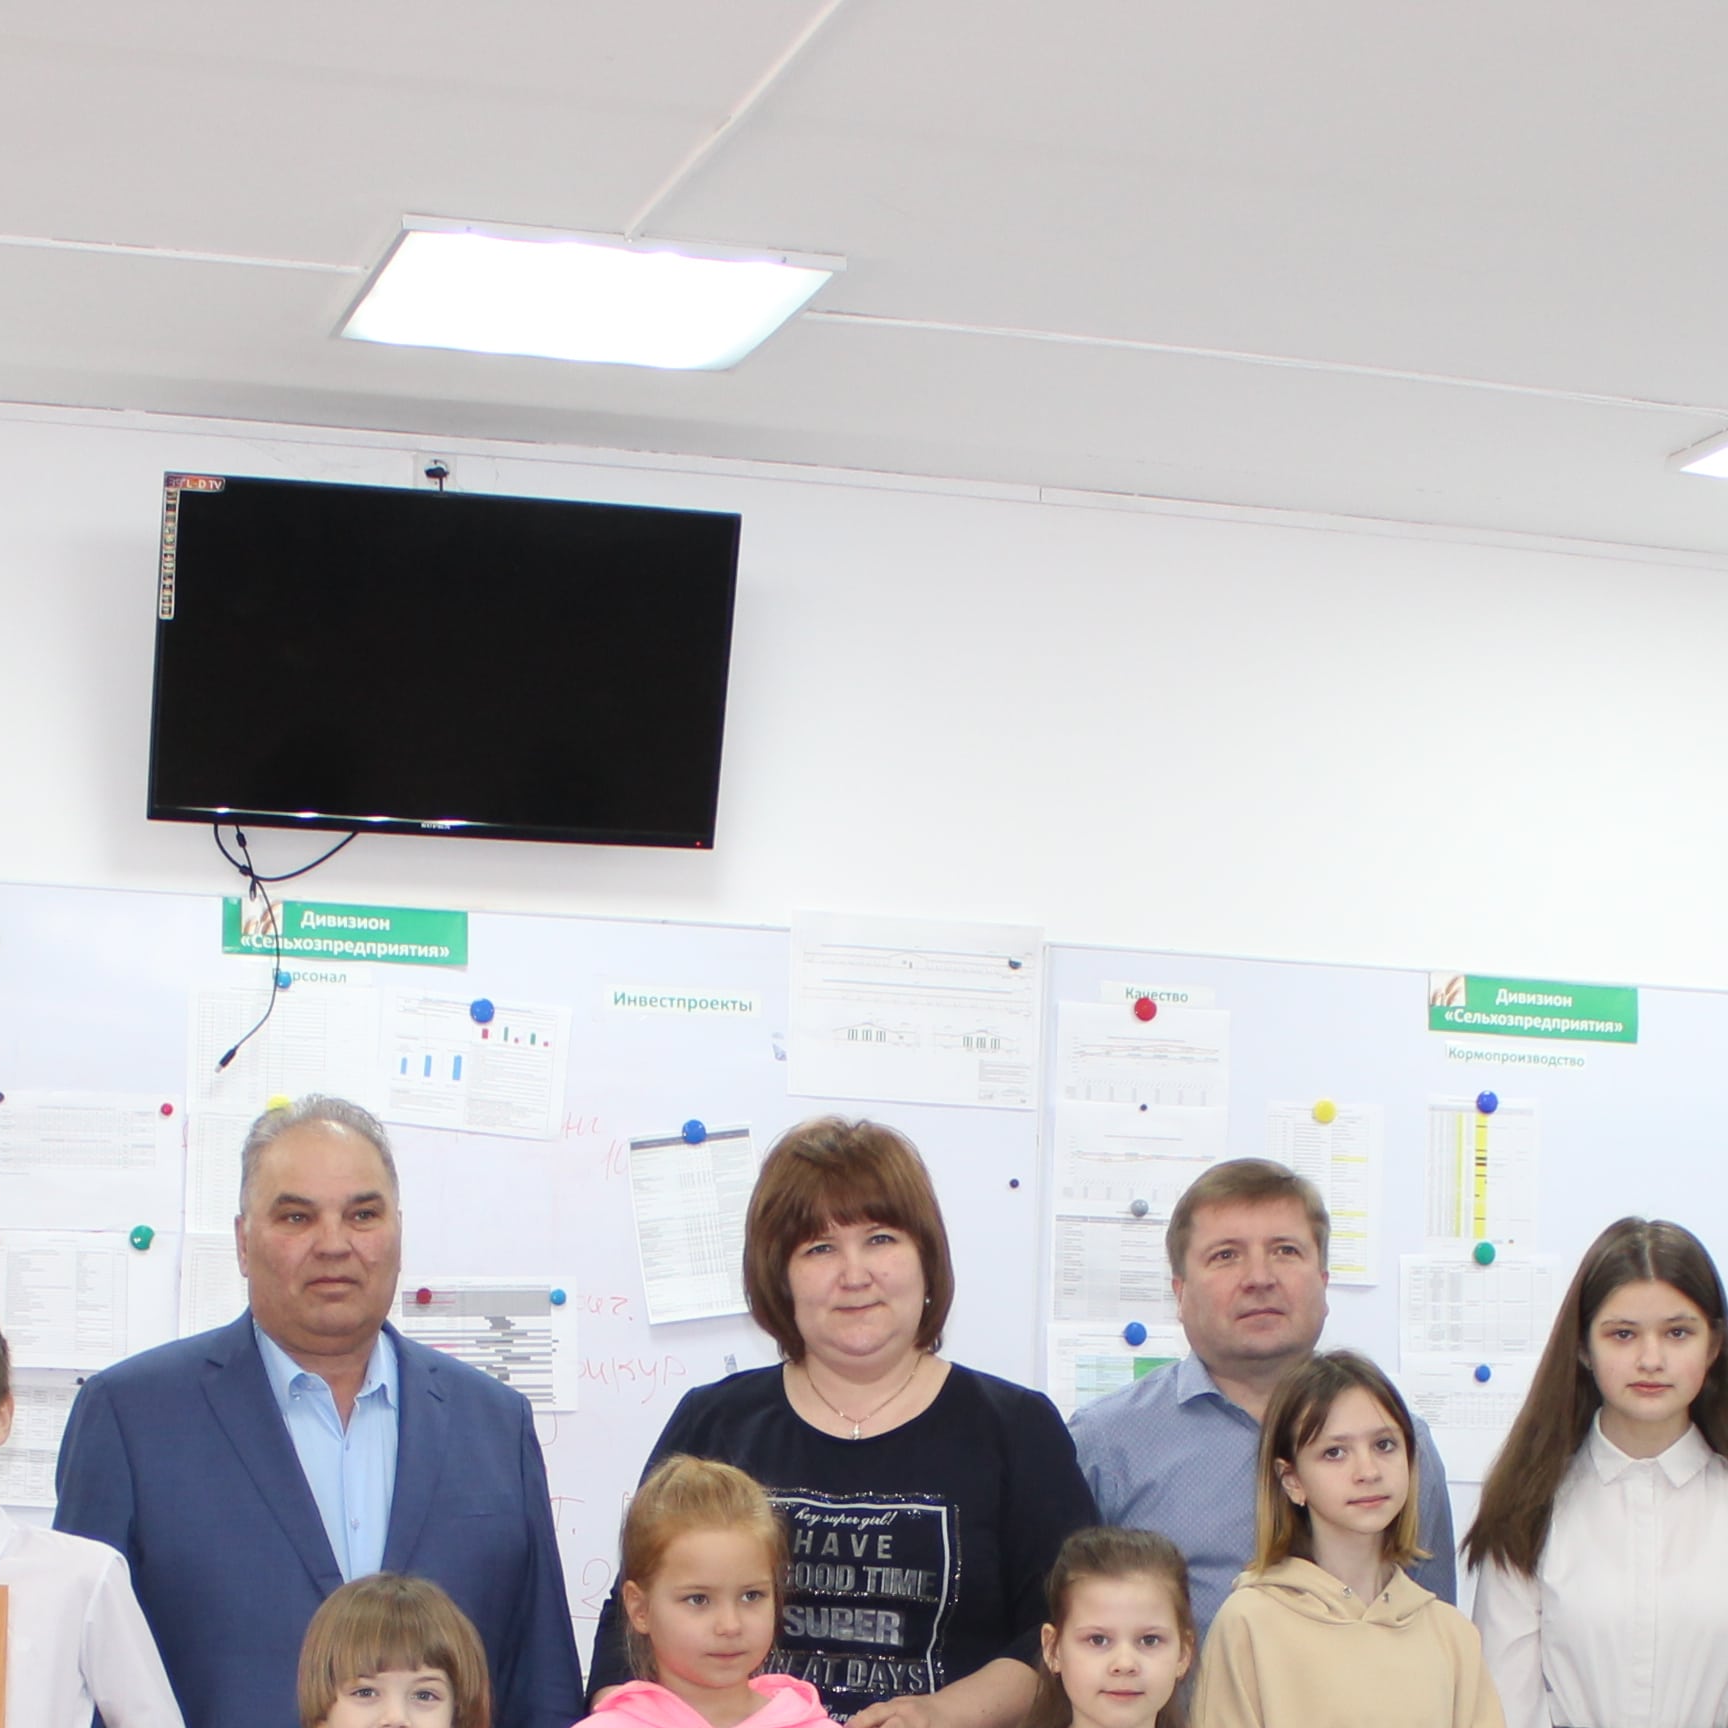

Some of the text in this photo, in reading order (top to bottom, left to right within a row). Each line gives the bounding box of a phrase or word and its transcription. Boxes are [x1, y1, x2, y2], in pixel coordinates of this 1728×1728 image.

[300, 910, 391, 933] Дивизион
[239, 933, 450, 960] «Сельхозпредприятия»
[612, 991, 754, 1013] Инвестпроекты
[1124, 986, 1189, 1003] Качество
[1494, 987, 1573, 1008] Дивизион
[1443, 1008, 1623, 1034] «Сельхозпредприятия»
[1446, 1045, 1586, 1068] Кормопроизводство
[793, 1529, 893, 1560] HAVE
[862, 1565, 938, 1597] TIME
[782, 1604, 904, 1647] SUPER
[845, 1658, 924, 1690] DAYS
